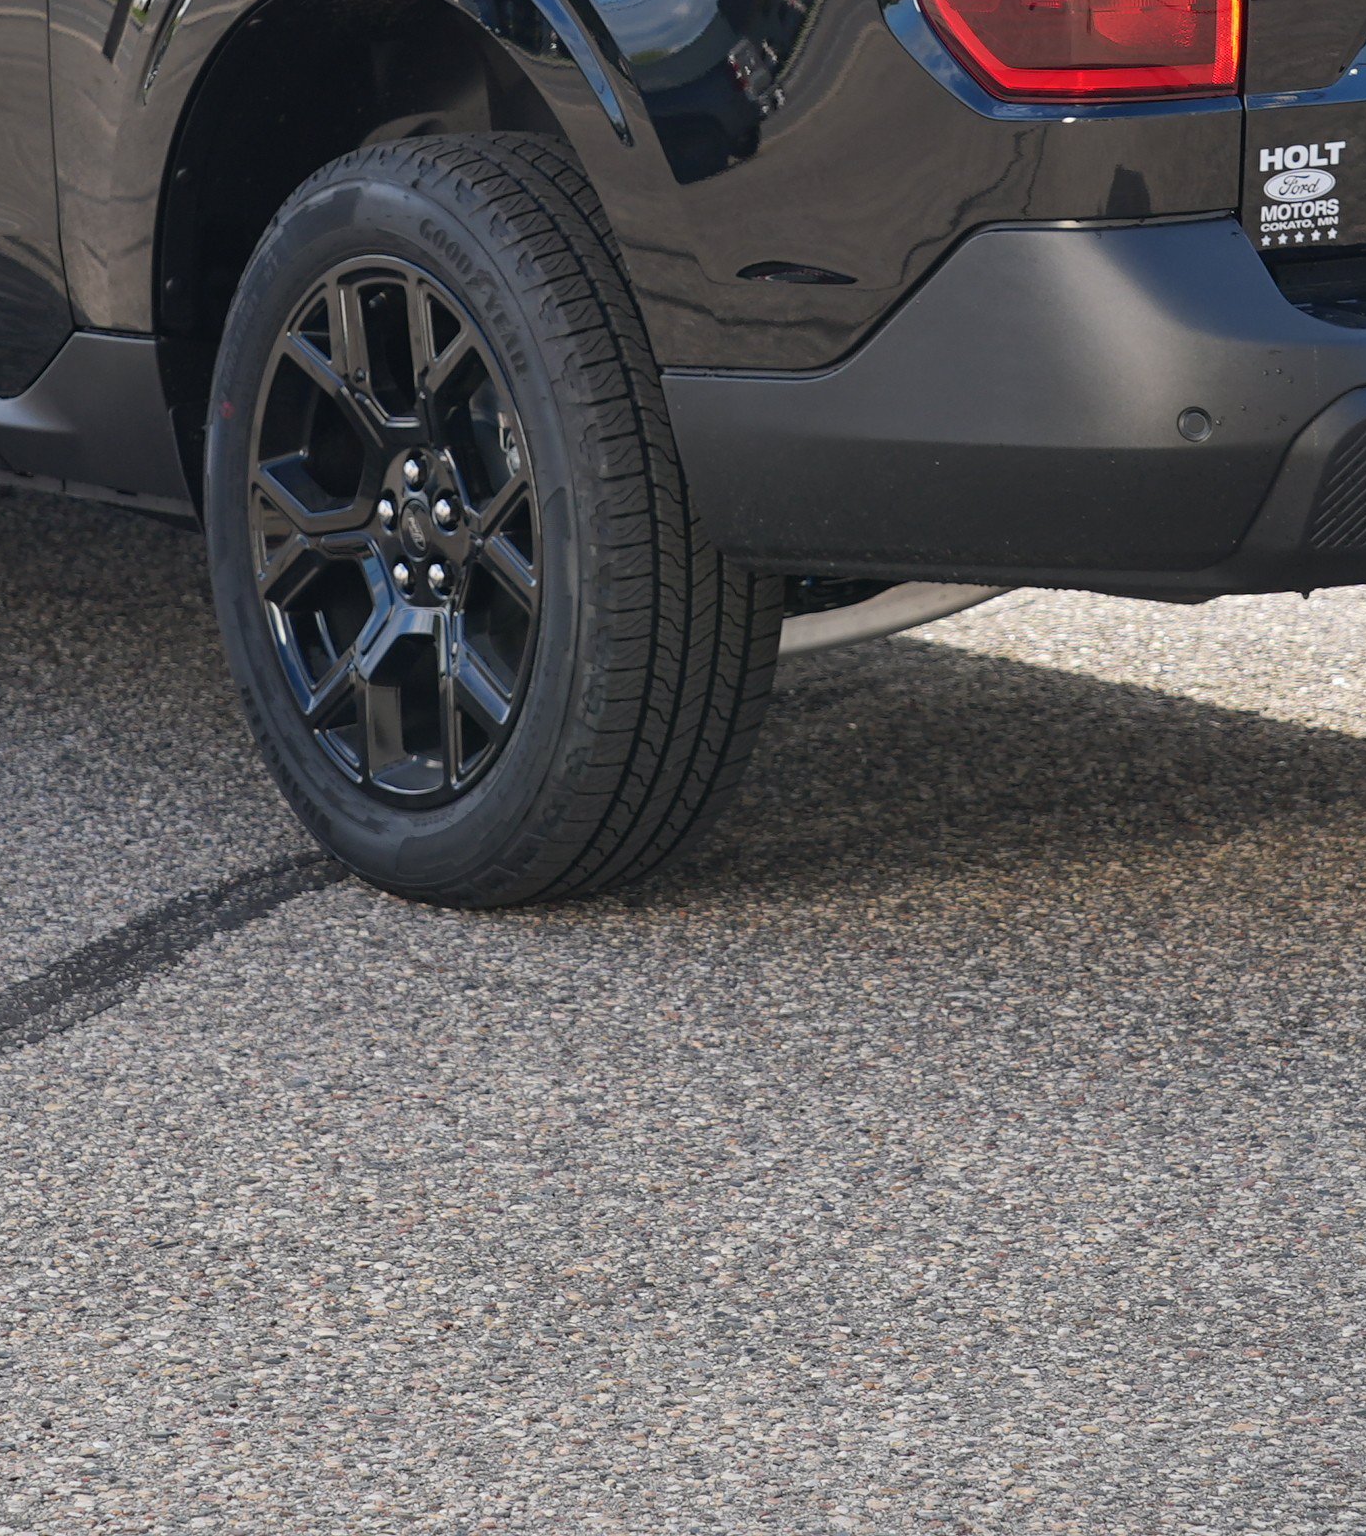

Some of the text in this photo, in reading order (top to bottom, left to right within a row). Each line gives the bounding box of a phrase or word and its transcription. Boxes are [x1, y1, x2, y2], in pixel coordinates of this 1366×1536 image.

[1259, 141, 1346, 172] HOLT
[1278, 174, 1321, 196] Ford
[1260, 198, 1340, 222] MOTORS
[1260, 215, 1339, 232] COKATO, MN
[419, 218, 529, 377] GOODYEAR
